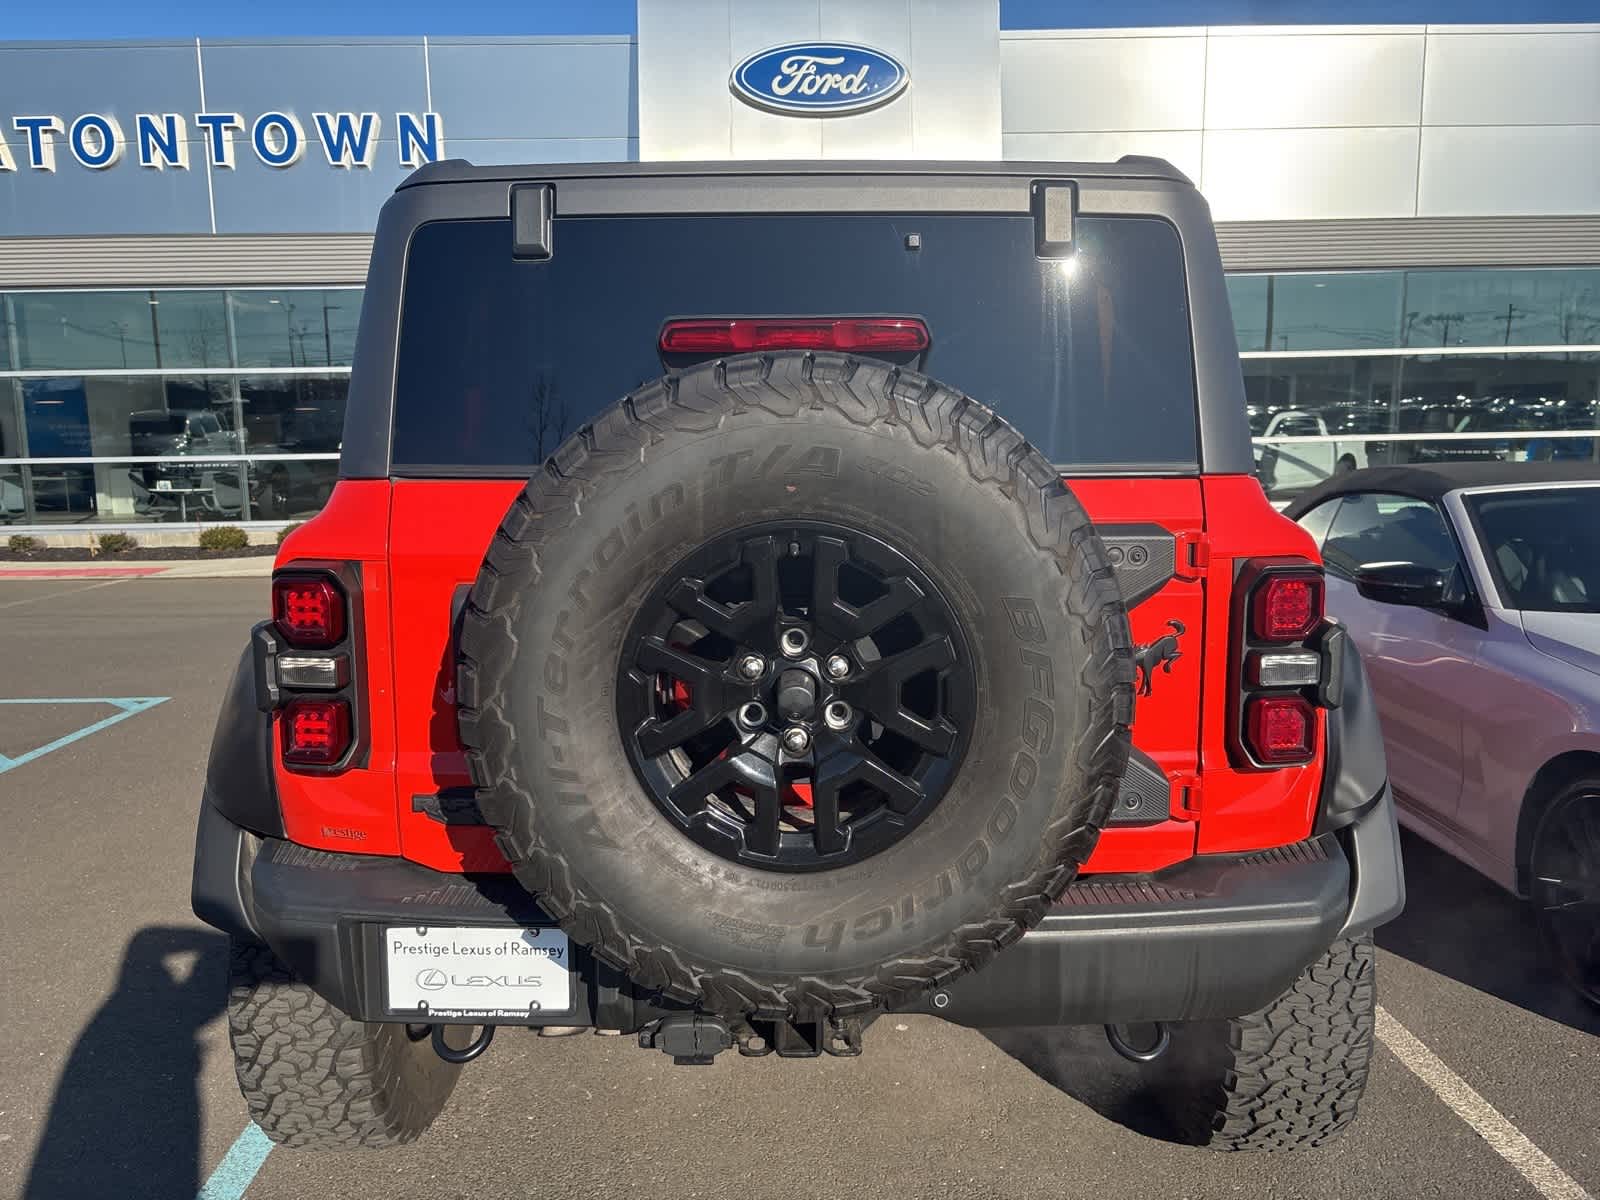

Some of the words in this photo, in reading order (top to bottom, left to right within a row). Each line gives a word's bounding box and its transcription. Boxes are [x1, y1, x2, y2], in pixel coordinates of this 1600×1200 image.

[771, 55, 871, 96] Ford
[393, 940, 449, 958] Prestige
[453, 942, 491, 956] Lexus
[495, 942, 508, 956] of
[511, 941, 565, 958] Ramsey
[451, 974, 543, 987] LEXUS
[428, 1009, 462, 1018] Prestige
[463, 1009, 487, 1017] Lexus
[488, 1009, 498, 1017] of
[498, 1009, 530, 1018] Ramsey
